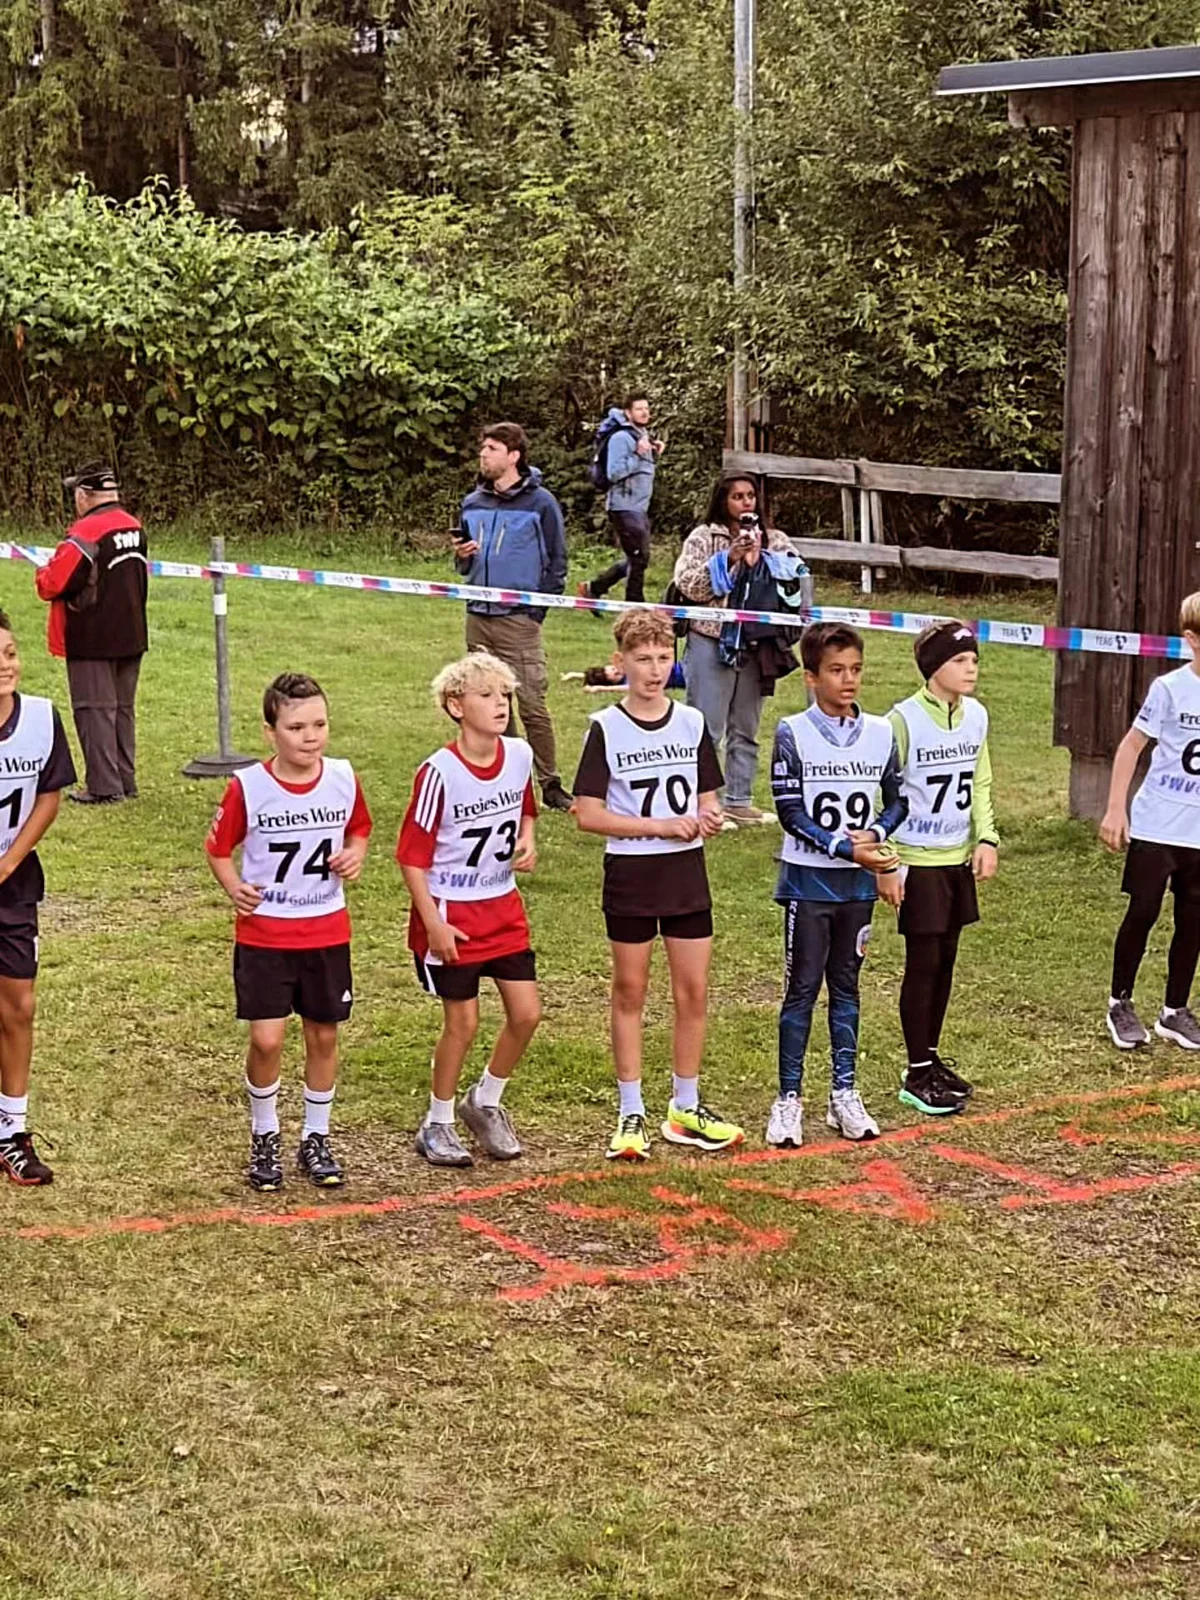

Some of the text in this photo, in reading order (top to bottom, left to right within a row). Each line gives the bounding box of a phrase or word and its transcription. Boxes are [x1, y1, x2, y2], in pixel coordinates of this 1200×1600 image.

[615, 742, 696, 768] Freies Wor
[804, 761, 849, 778] Freies
[915, 740, 980, 763] Freies Wor
[1181, 738, 1200, 776] 6
[0, 787, 23, 829] 1
[453, 788, 524, 819] Freies Wor
[629, 774, 692, 818] 70
[812, 791, 871, 833] 69
[926, 771, 974, 815] 75
[257, 810, 309, 829] Freies
[268, 837, 333, 884] 74
[460, 819, 517, 868] 73
